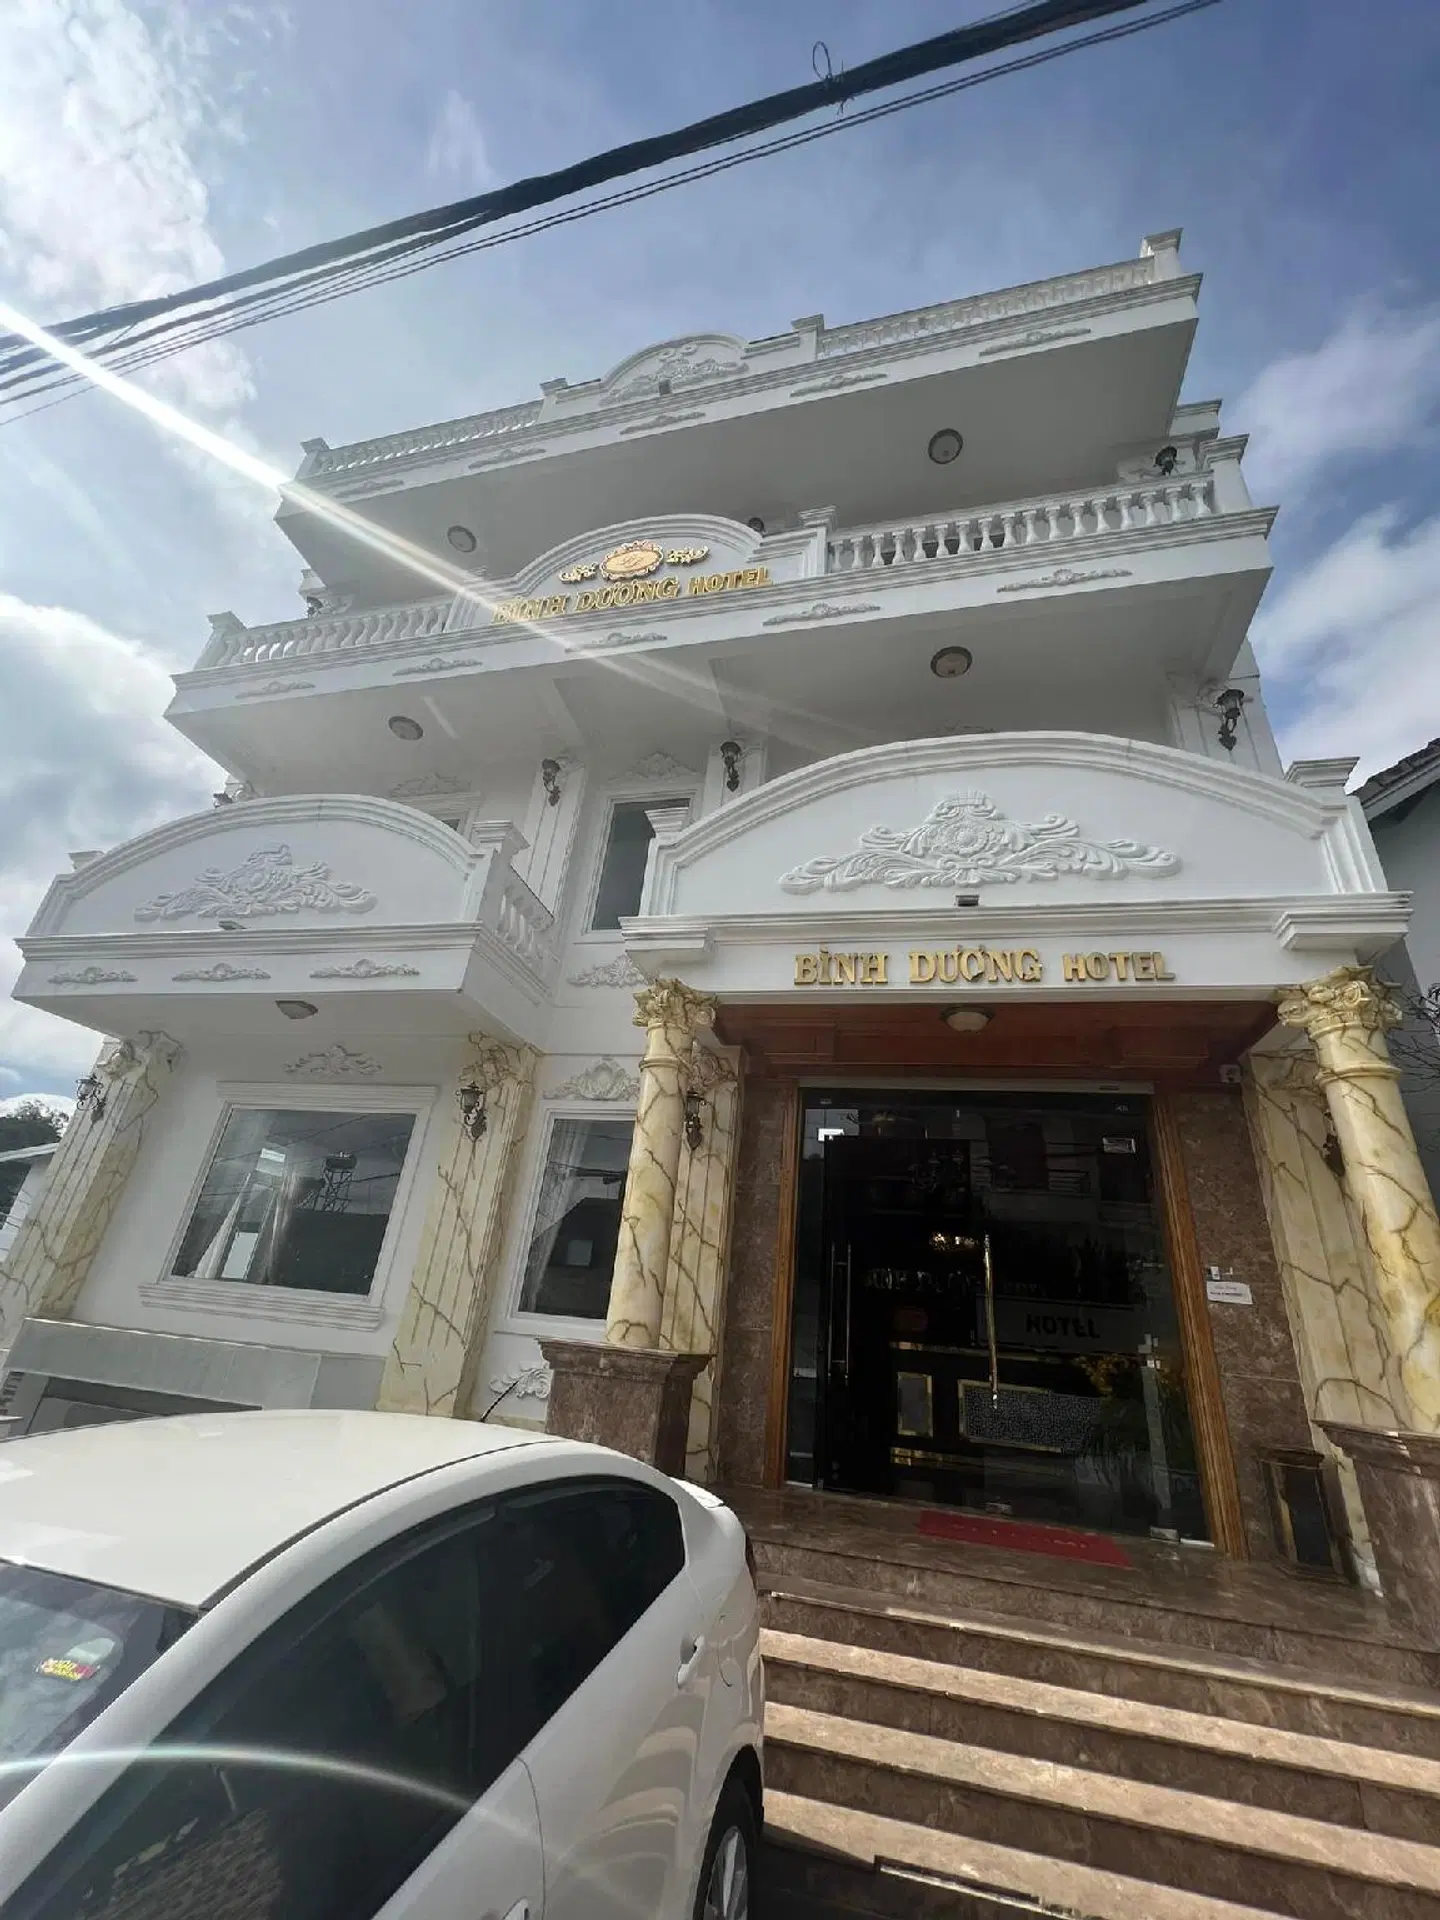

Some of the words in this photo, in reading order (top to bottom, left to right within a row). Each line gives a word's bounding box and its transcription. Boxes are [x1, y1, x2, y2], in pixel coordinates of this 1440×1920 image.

[688, 566, 772, 593] HOTEL
[794, 944, 889, 985] BÌNH
[908, 944, 1043, 983] DƯƠNG
[1063, 951, 1175, 982] HOTEL
[1026, 1312, 1101, 1338] HOTEL
